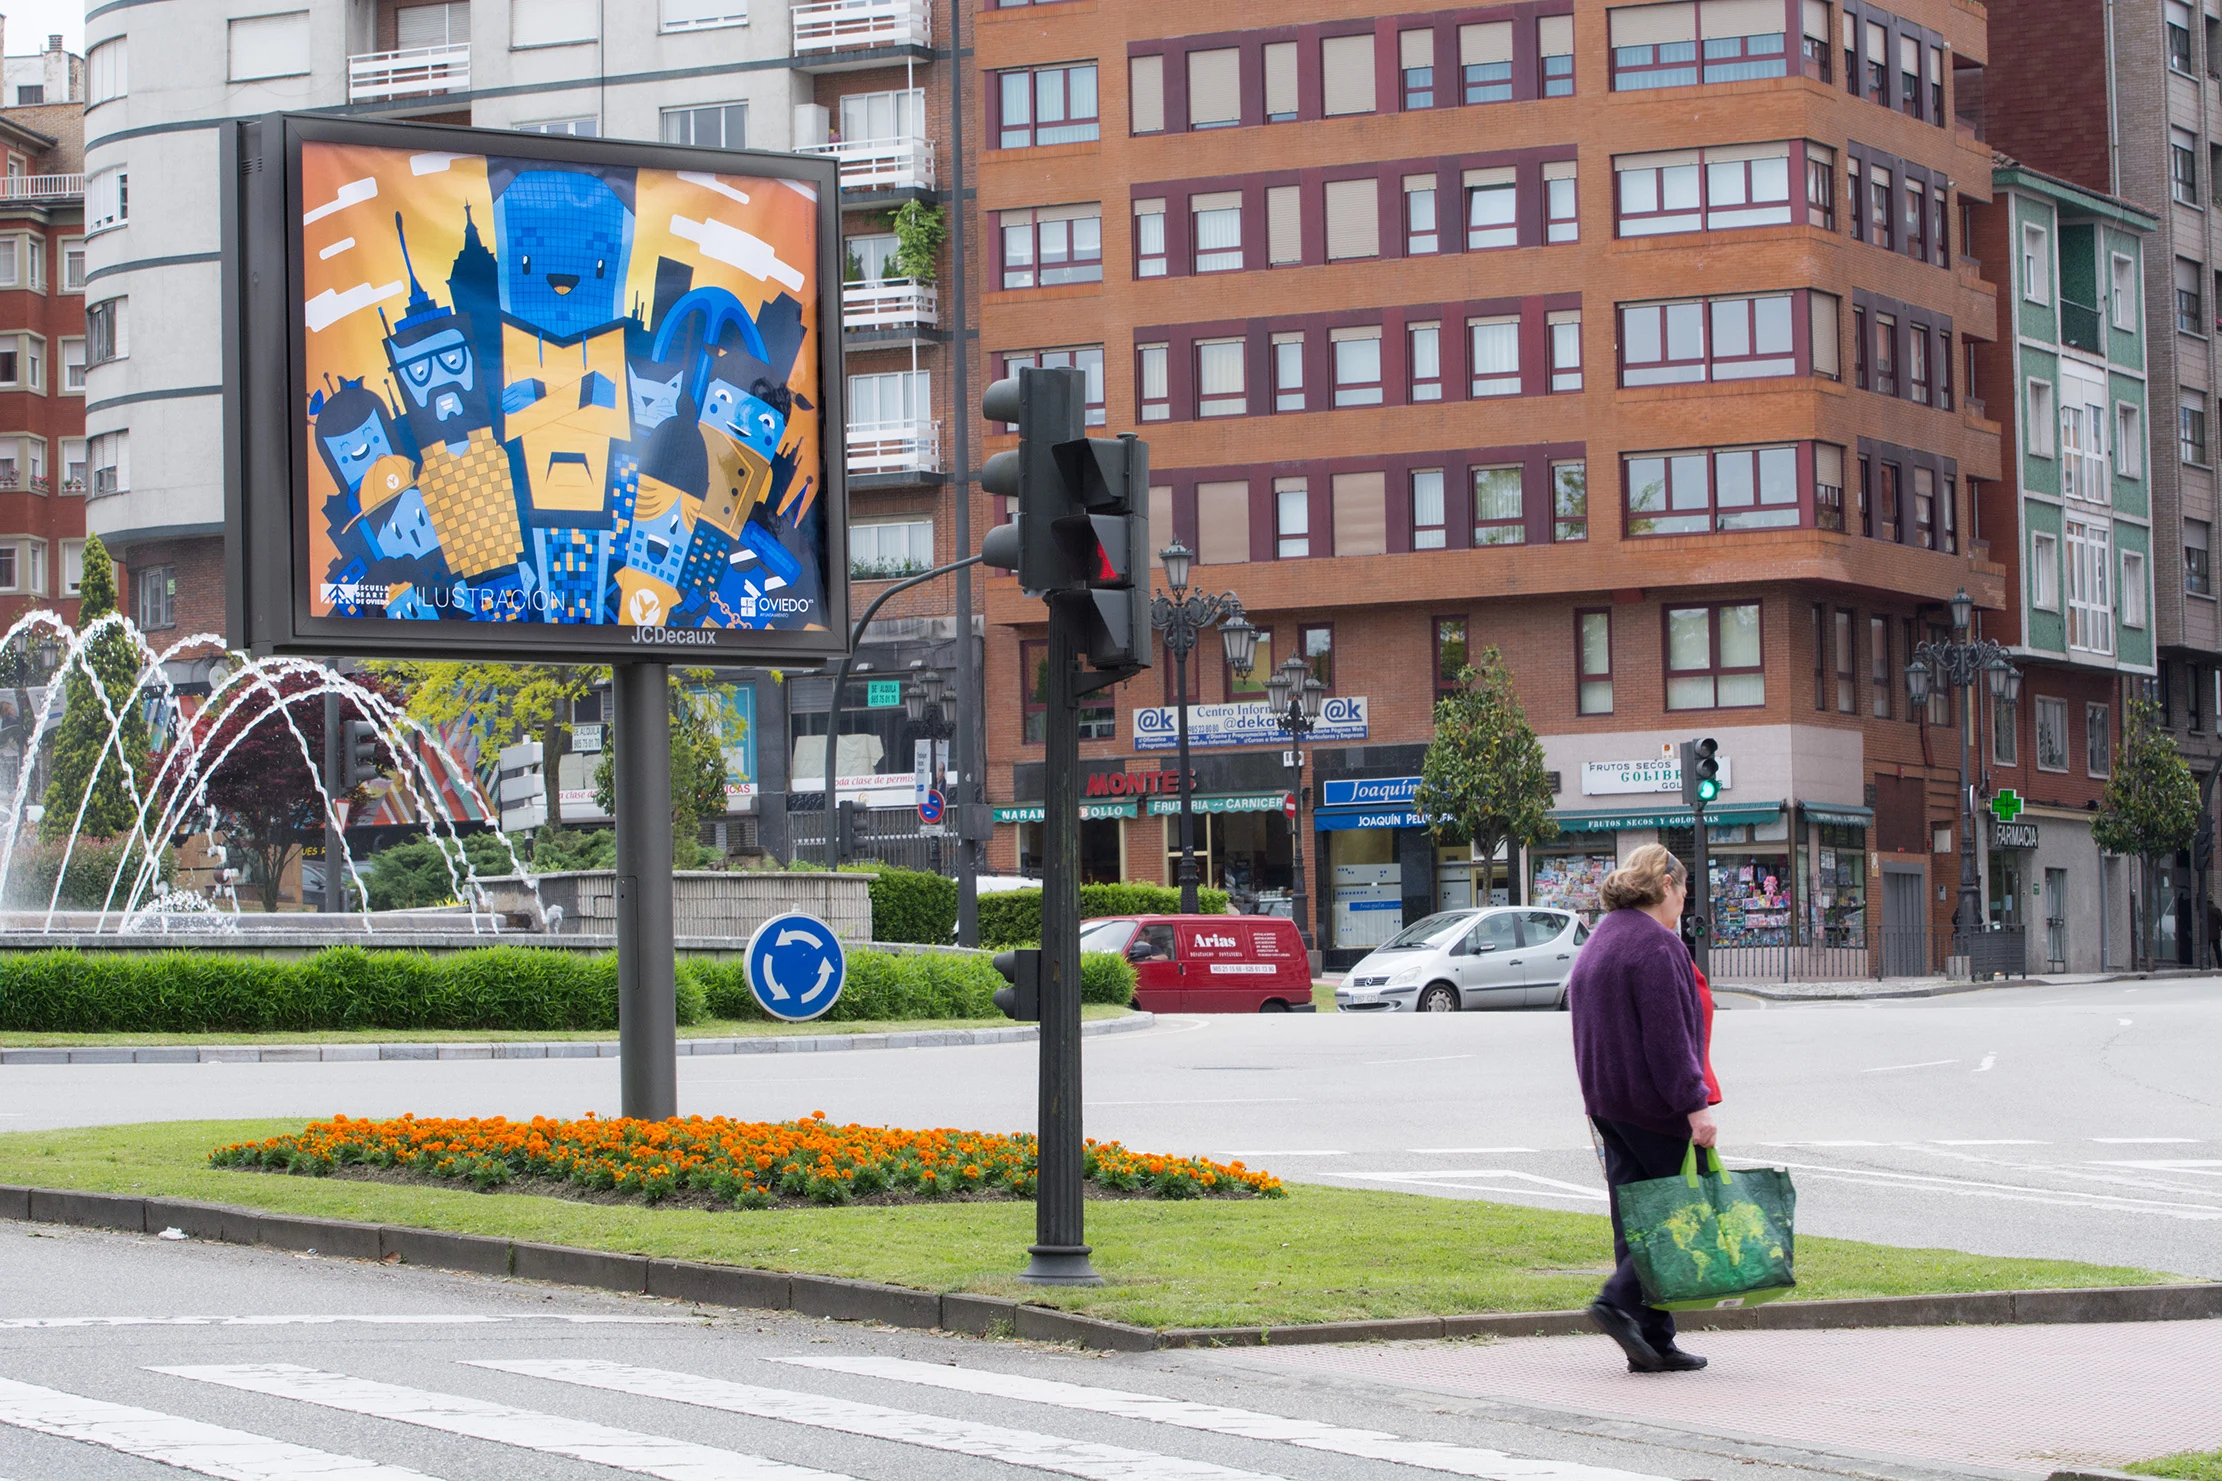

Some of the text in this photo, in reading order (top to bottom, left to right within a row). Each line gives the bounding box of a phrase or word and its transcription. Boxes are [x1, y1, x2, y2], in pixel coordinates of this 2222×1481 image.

[356, 584, 389, 592] ESCUELA
[416, 586, 566, 611] ILUSTRACIÓN
[631, 625, 717, 645] JCDecaux
[1197, 706, 1234, 718] Centro
[1325, 698, 1363, 723] @k
[1138, 709, 1175, 732] @k
[1589, 761, 1671, 772] FRUTOS SECOS
[835, 774, 915, 787] oda clase de permis
[1350, 779, 1418, 802] Joaquín
[1154, 797, 1284, 812] FRUTRIA CARNICER
[1358, 813, 1401, 827] JOAQUÍN
[1588, 815, 1719, 829] FRUTOS SECOS Y GOLOSNAS
[1996, 824, 2038, 848] FARMACIA
[1194, 933, 1237, 948] Arias
